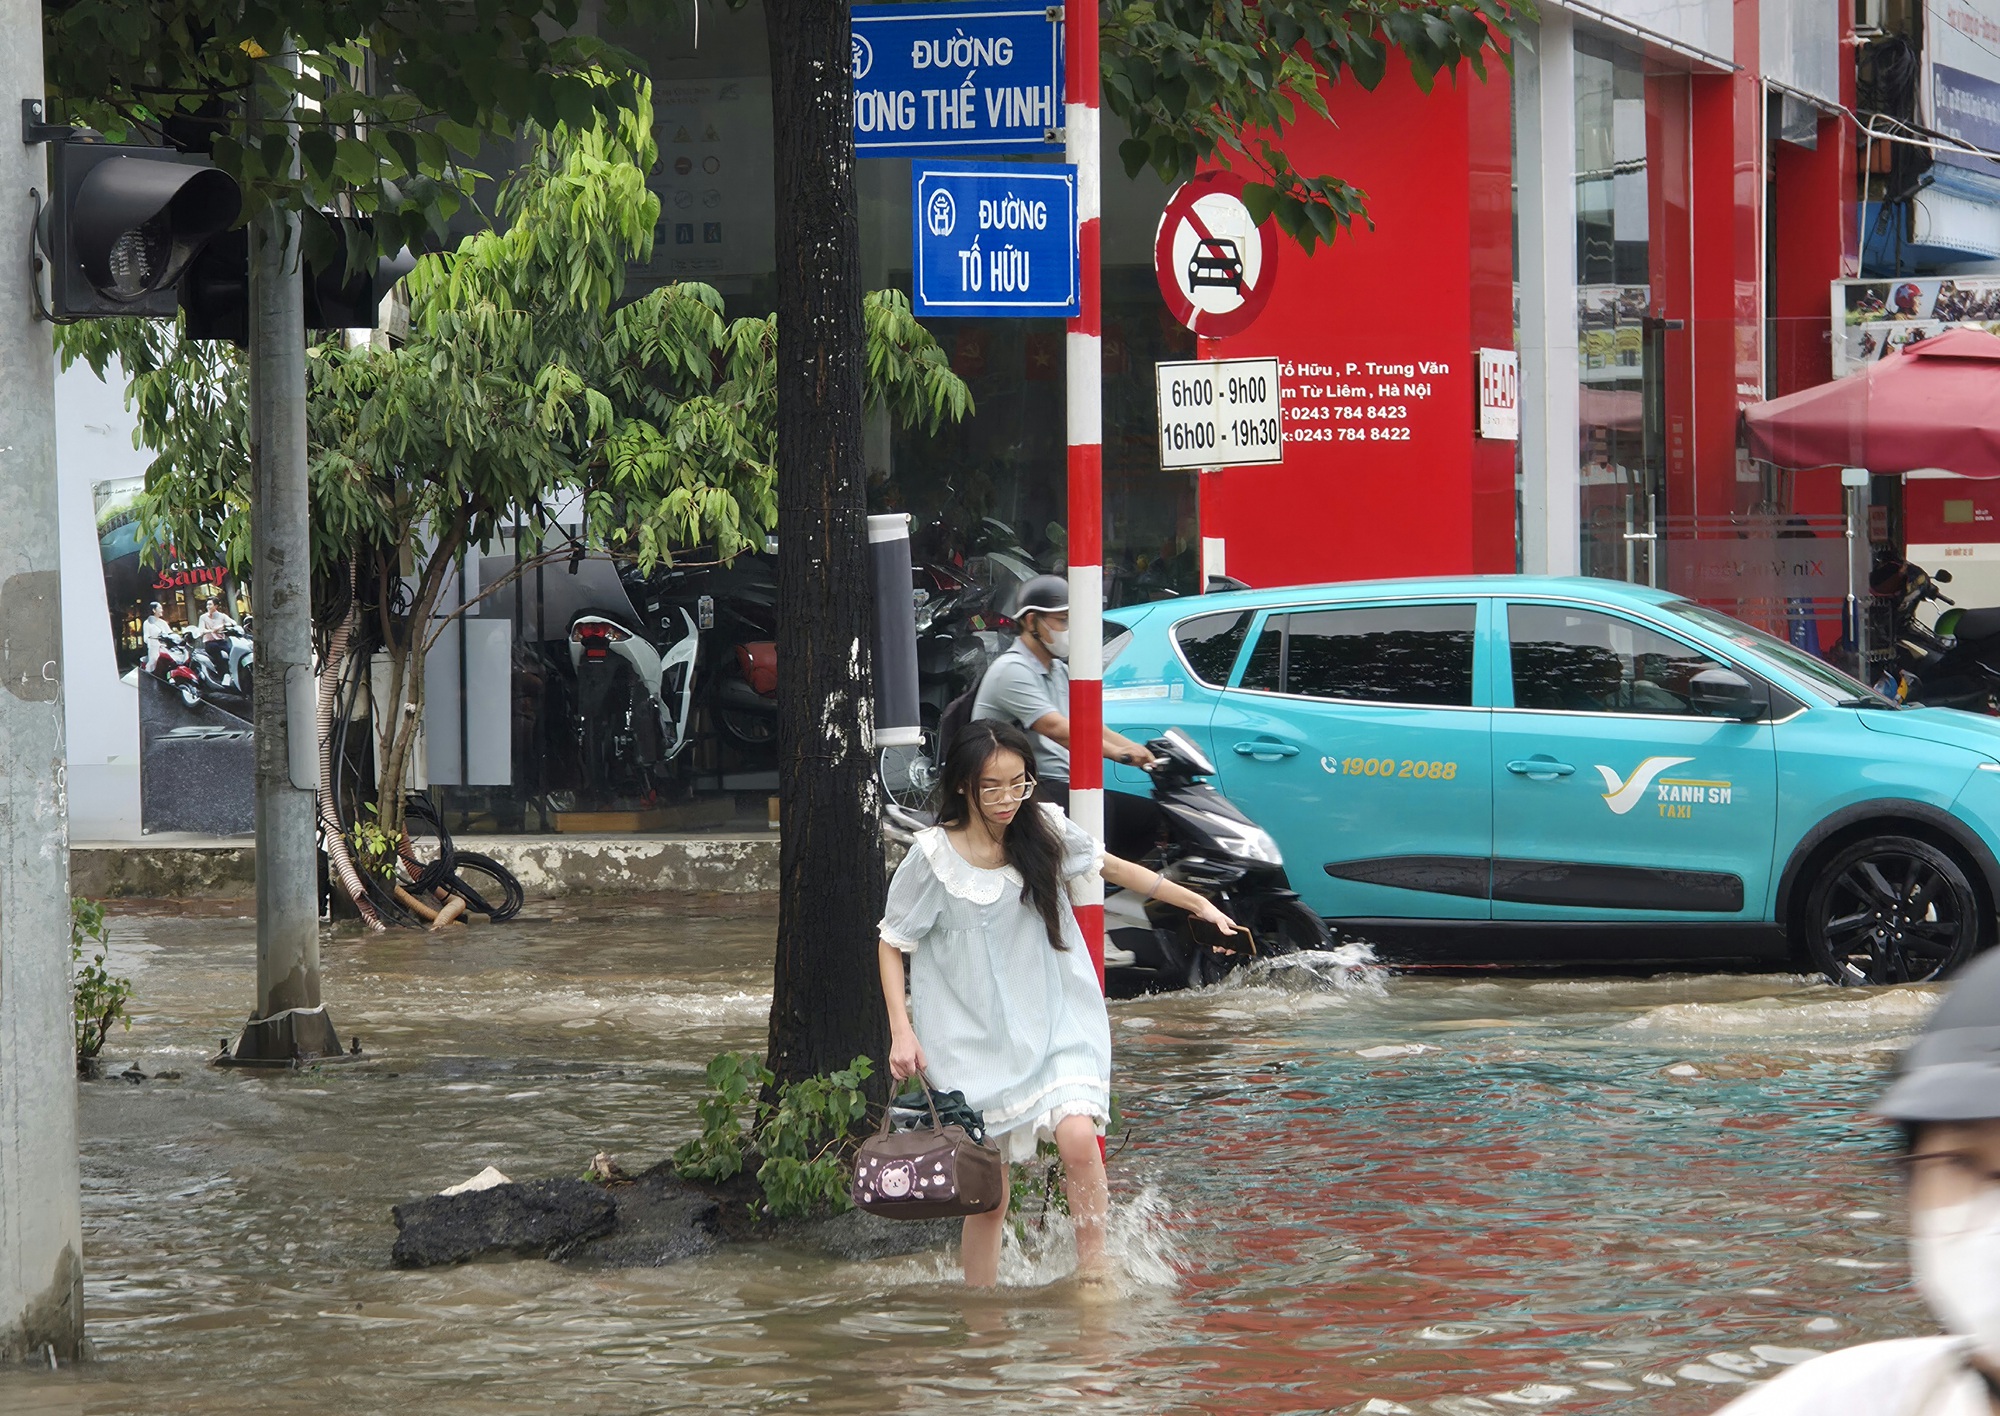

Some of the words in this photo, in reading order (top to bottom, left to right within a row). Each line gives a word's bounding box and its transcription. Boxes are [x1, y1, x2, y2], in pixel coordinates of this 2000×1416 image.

[912, 28, 1013, 69] ĐƯỜNG
[853, 88, 916, 132] ƠNG
[921, 69, 976, 130] THẾ
[985, 85, 1050, 128] VINH
[979, 191, 1047, 230] ĐƯỜNG
[958, 234, 982, 292] TỐ
[990, 244, 1029, 292] HỮU
[1298, 363, 1332, 376] Hữu
[1346, 363, 1361, 375] P.
[1366, 362, 1414, 378] Trung
[1418, 362, 1449, 374] Văn
[1172, 378, 1213, 407] 6h00
[1229, 376, 1266, 404] 9h00
[1300, 384, 1323, 398] Từ
[1326, 384, 1366, 398] Liêm
[1378, 384, 1400, 396] Hà
[1404, 383, 1431, 399] Nội
[1483, 361, 1515, 409] HEAD
[1334, 406, 1363, 419] 784
[1367, 406, 1407, 419] 8423
[1164, 421, 1215, 450] 16h00
[1231, 418, 1277, 446] 19h30
[1338, 428, 1366, 441] 784
[1370, 427, 1411, 441] 8422
[1341, 757, 1395, 776] 1900
[1398, 760, 1457, 780] 2088
[1658, 785, 1704, 803] XANH
[1708, 787, 1732, 804] SM
[1658, 804, 1691, 818] TAXI
